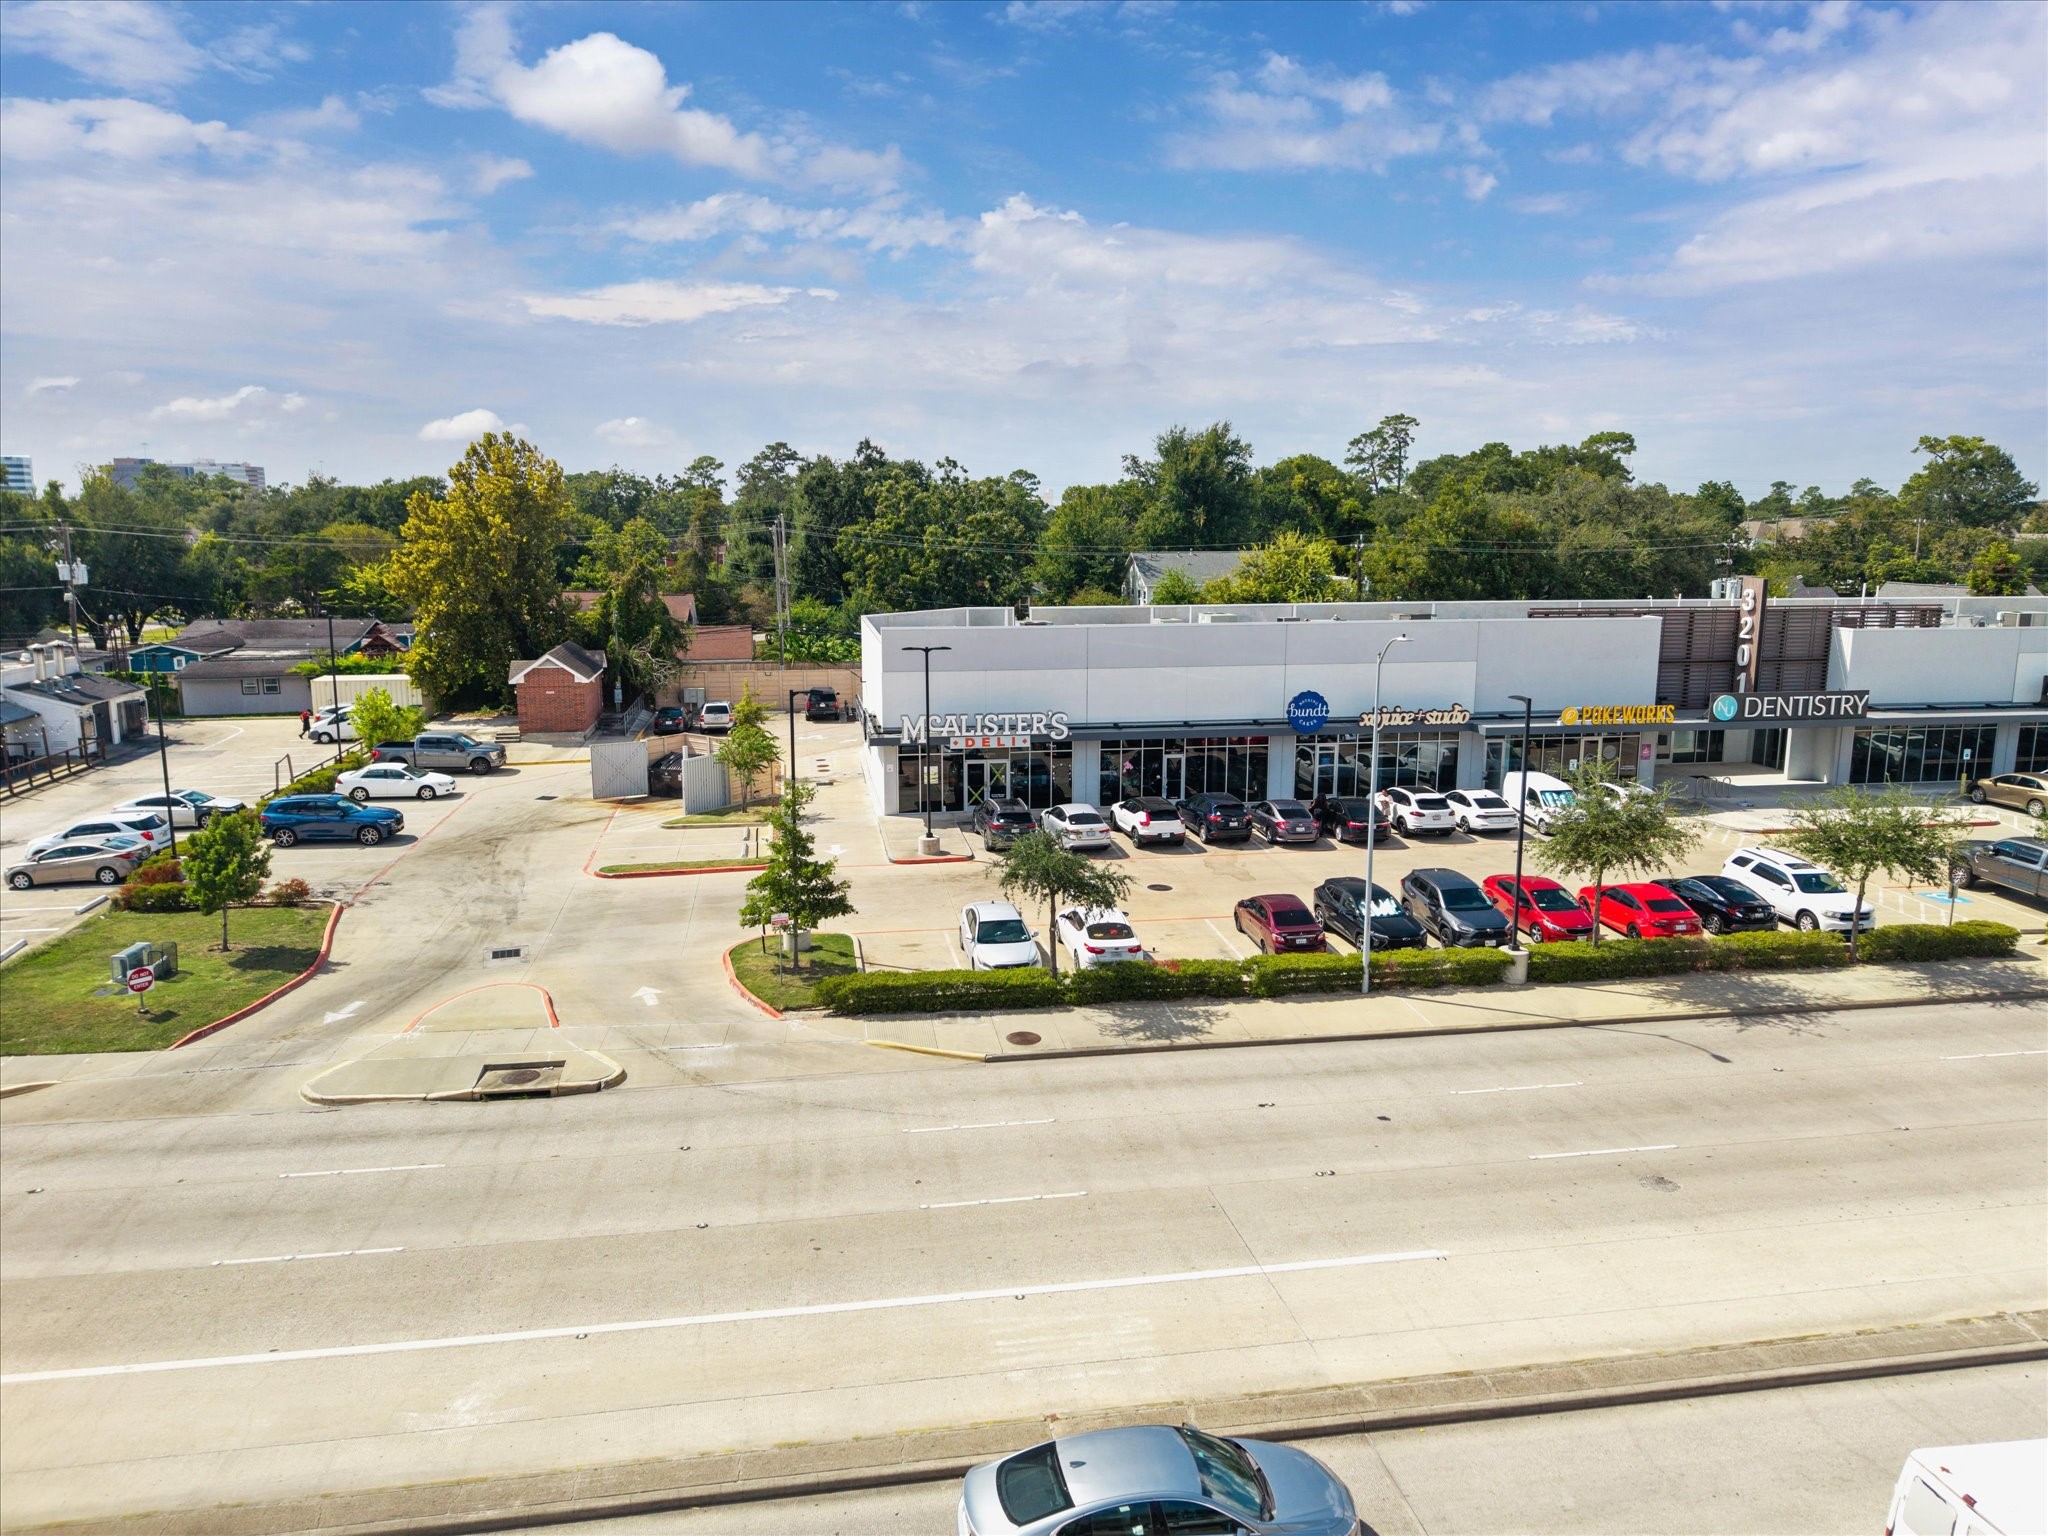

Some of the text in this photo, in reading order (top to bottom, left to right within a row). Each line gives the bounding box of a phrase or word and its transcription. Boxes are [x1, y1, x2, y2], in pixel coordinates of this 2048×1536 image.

[1736, 588, 1755, 693] 3201
[1289, 702, 1328, 717] bundt
[1377, 707, 1415, 730] juice
[1424, 703, 1470, 725] studio
[1580, 704, 1675, 725] POKEWORKS
[1744, 694, 1869, 718] DENTISTRY
[964, 736, 1016, 748] DELI
